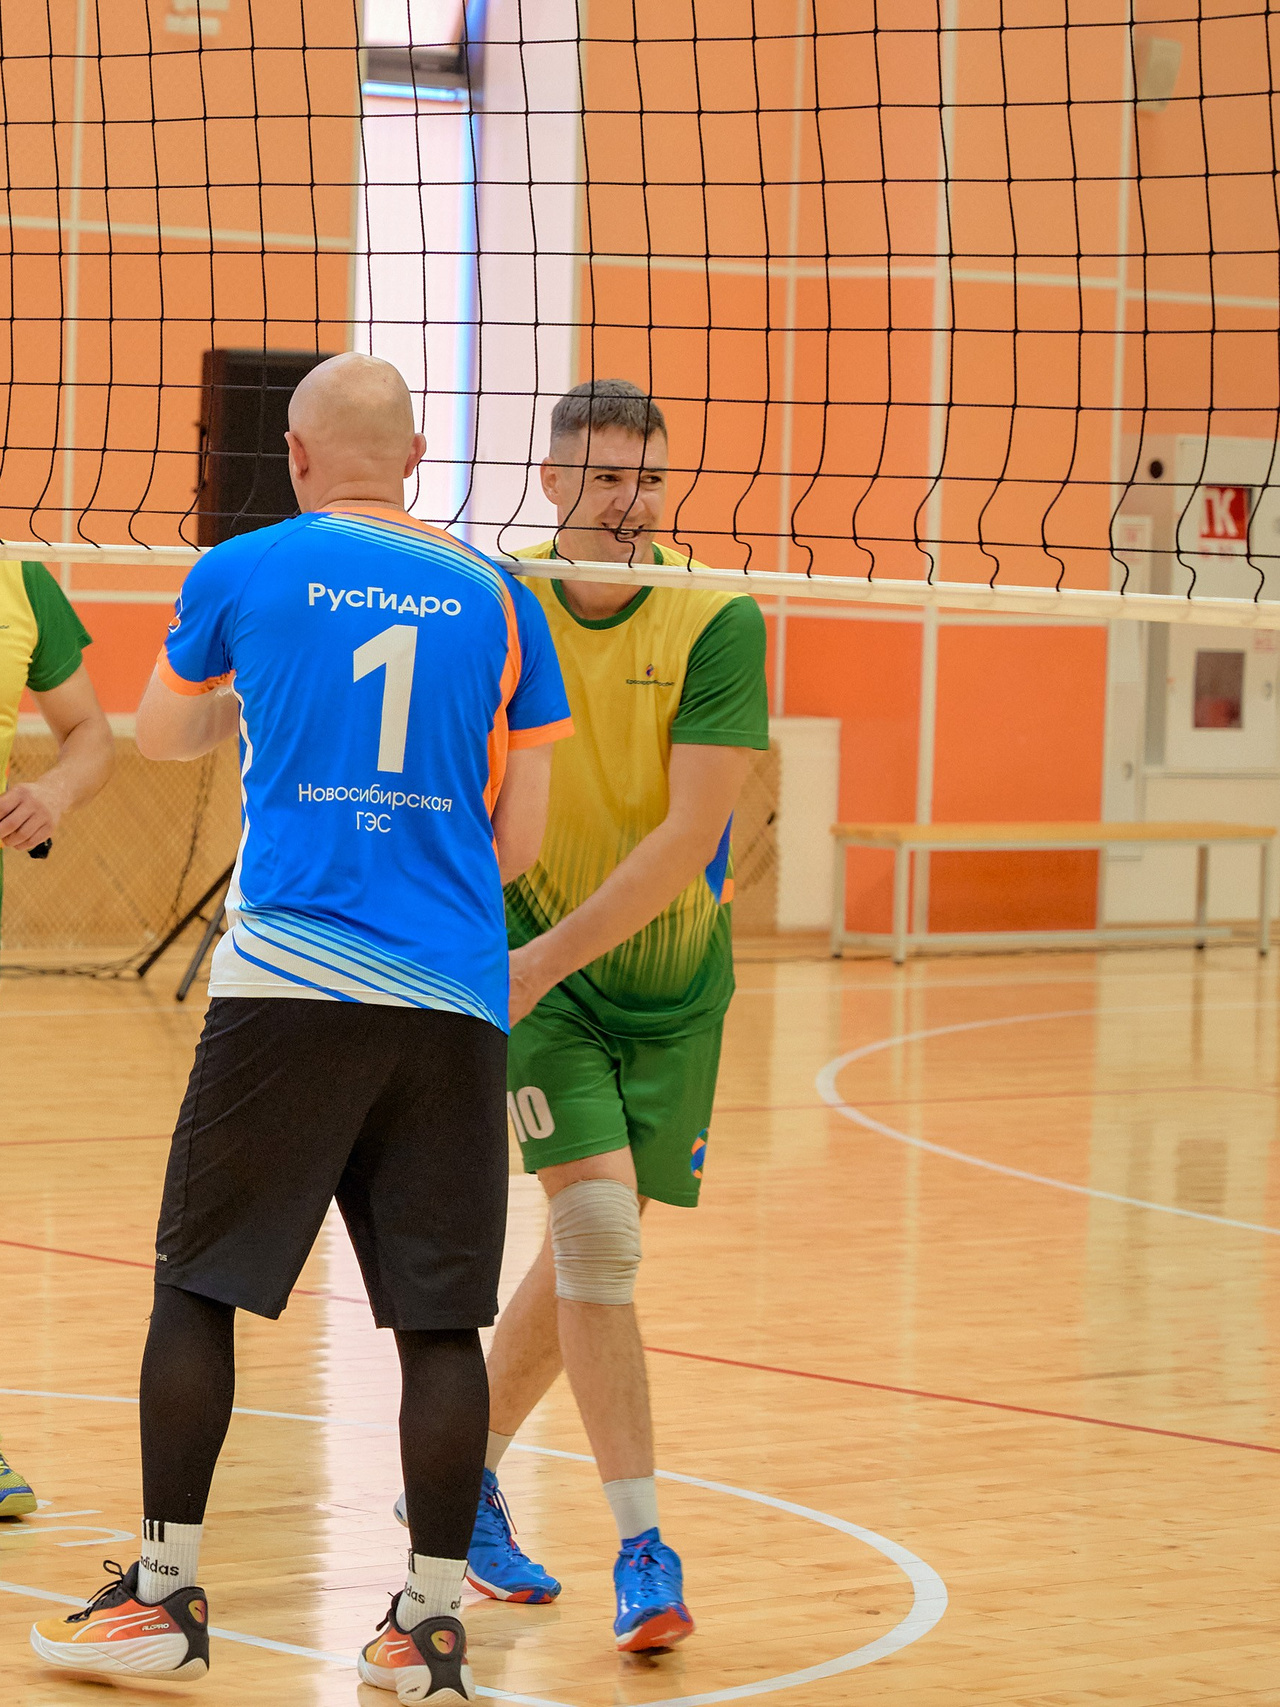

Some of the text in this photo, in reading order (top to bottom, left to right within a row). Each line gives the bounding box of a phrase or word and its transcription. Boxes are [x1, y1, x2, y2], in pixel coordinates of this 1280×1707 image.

[308, 583, 462, 618] РусГидро
[353, 624, 418, 773] 1
[298, 783, 452, 812] Новосибирская
[356, 812, 392, 833] ГЭС
[507, 1086, 556, 1143] 10
